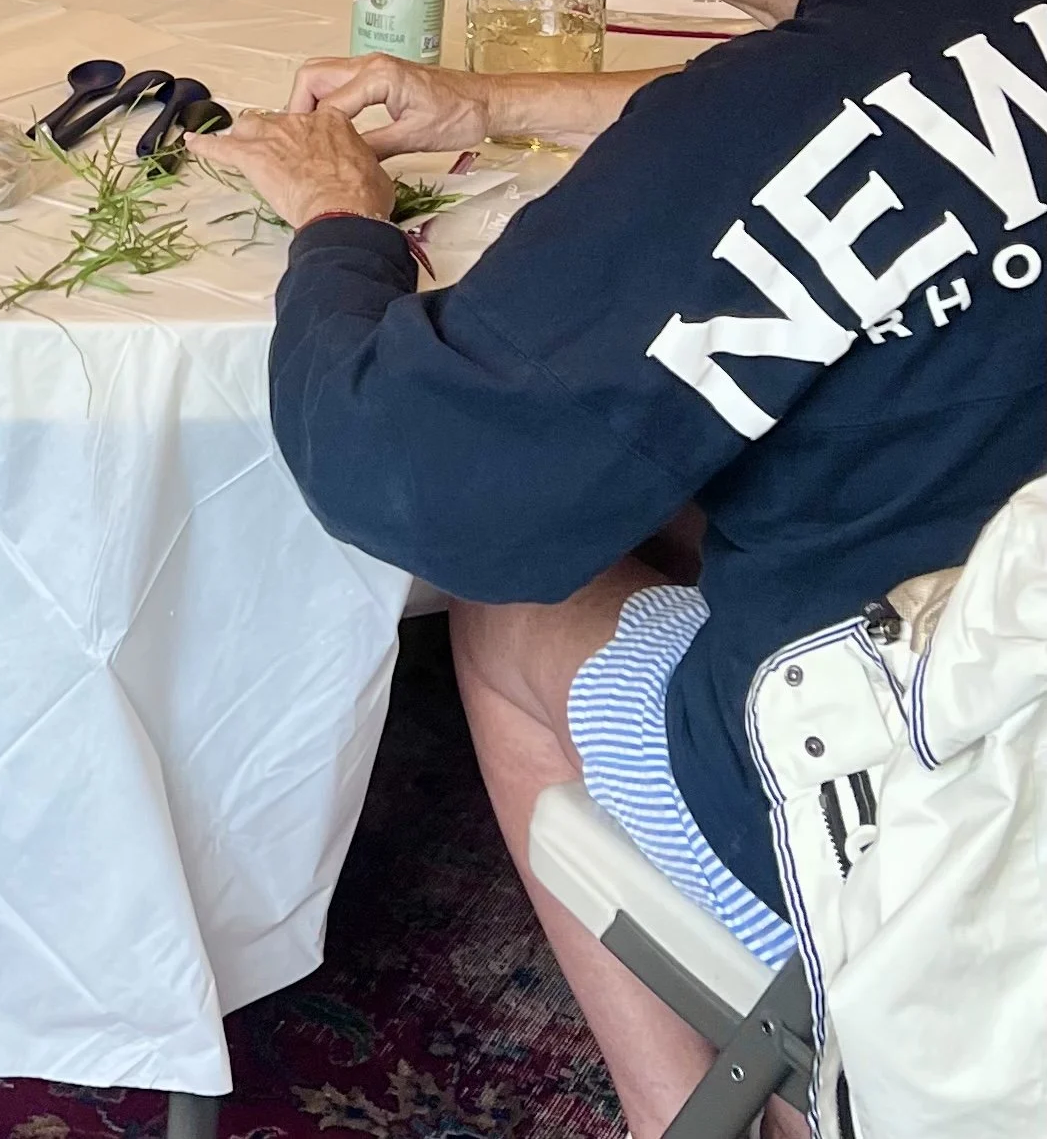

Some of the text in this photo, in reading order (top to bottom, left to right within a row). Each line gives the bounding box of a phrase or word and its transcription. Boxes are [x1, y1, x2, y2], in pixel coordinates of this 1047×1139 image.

[365, 12, 395, 31] WHITE
[373, 31, 406, 43] VINEGAR
[645, 2, 1047, 441] NEW
